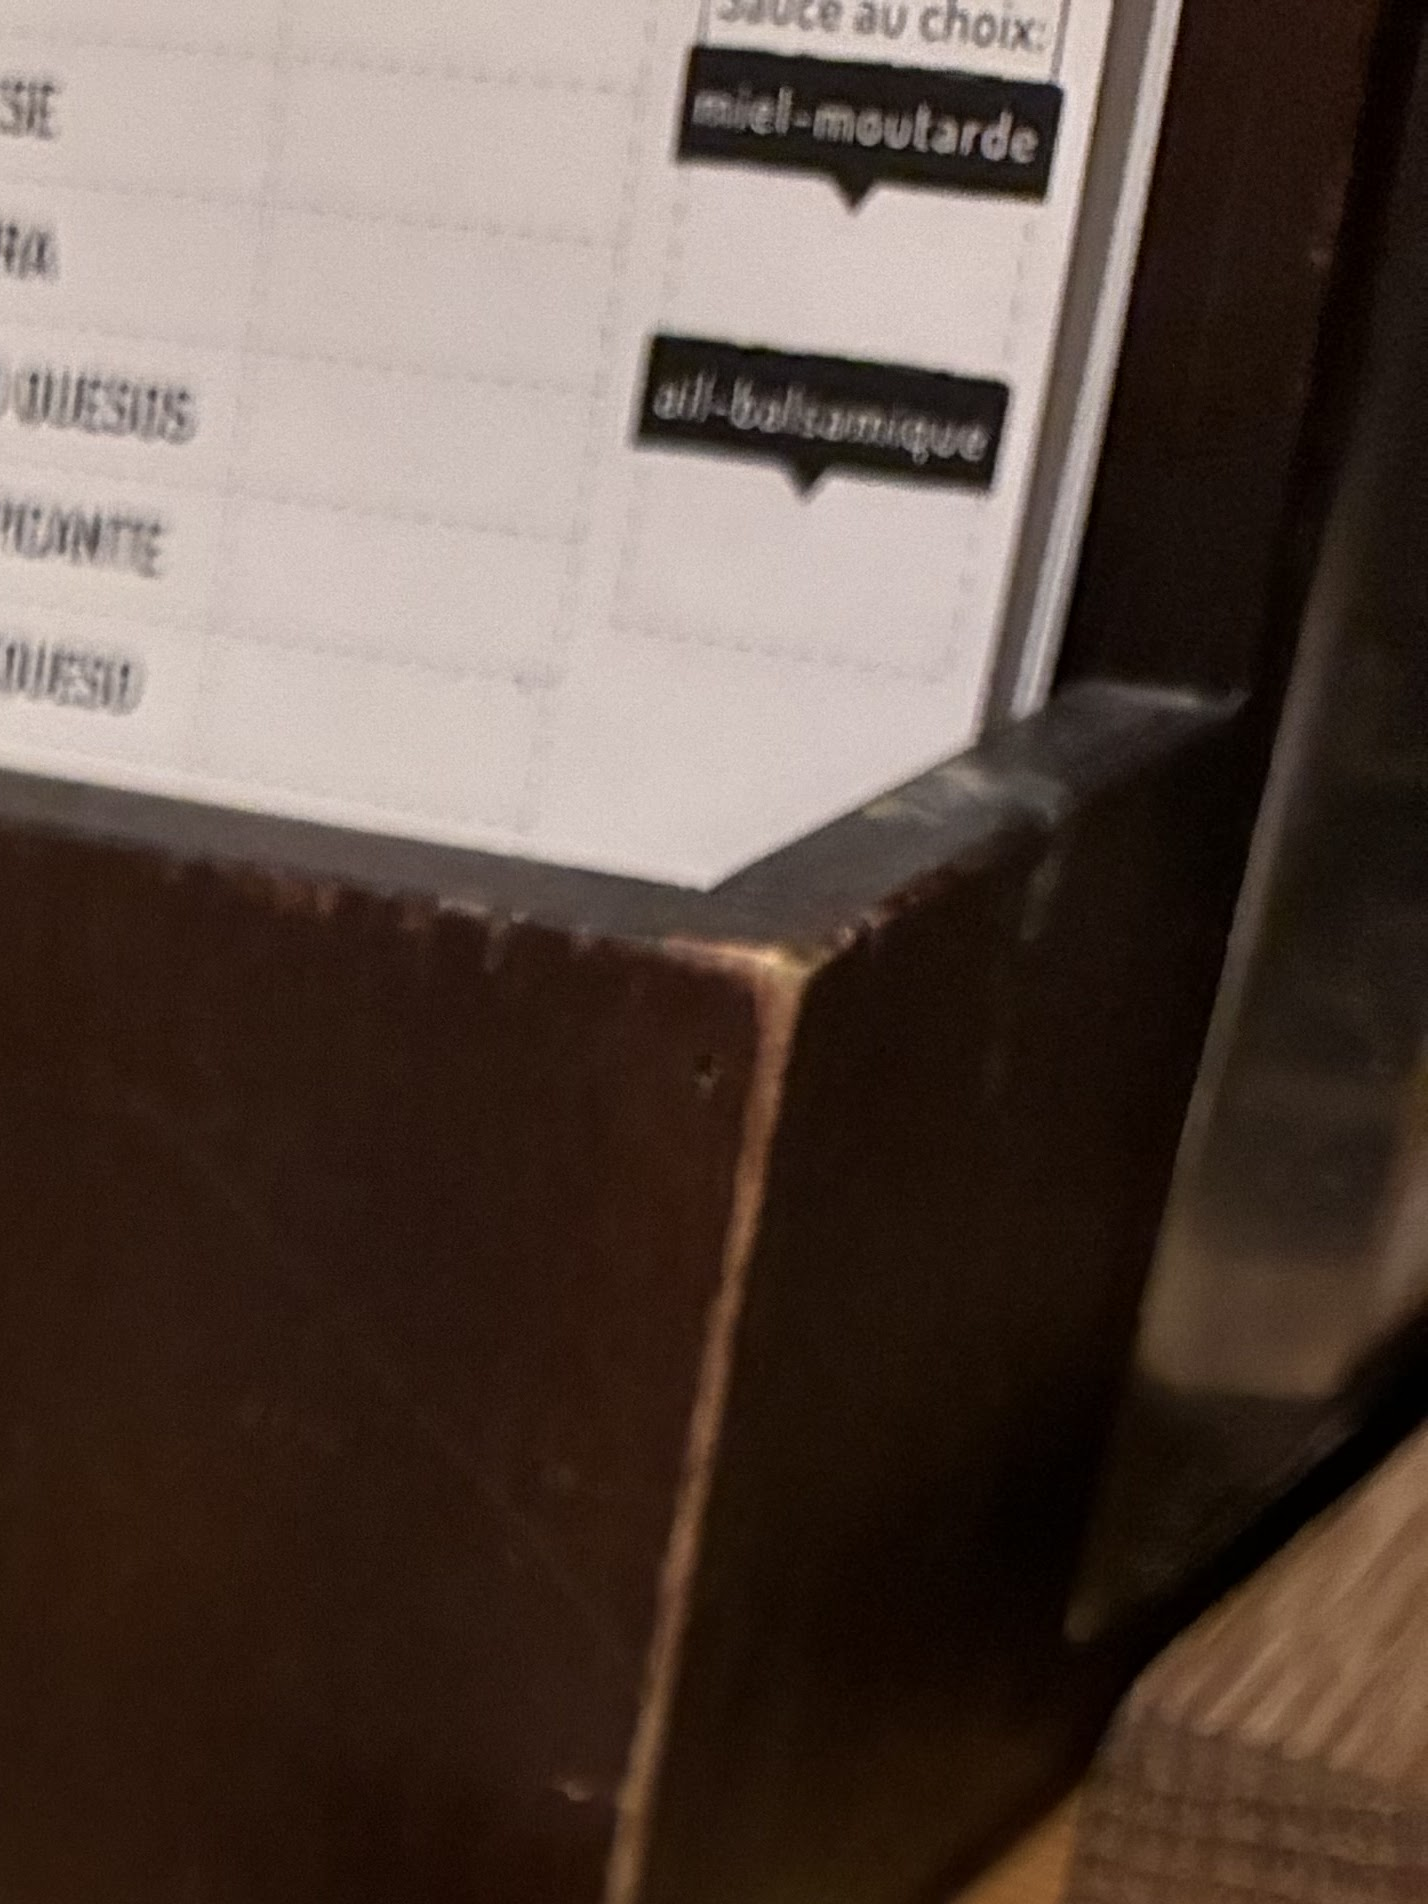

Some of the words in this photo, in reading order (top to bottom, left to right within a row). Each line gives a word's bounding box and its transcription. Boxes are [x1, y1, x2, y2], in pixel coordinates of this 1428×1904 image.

[853, 1, 908, 39] au
[690, 84, 1042, 165] miel-moutarde
[14, 366, 196, 445] QUESOS
[652, 366, 992, 465] ail-balsamique
